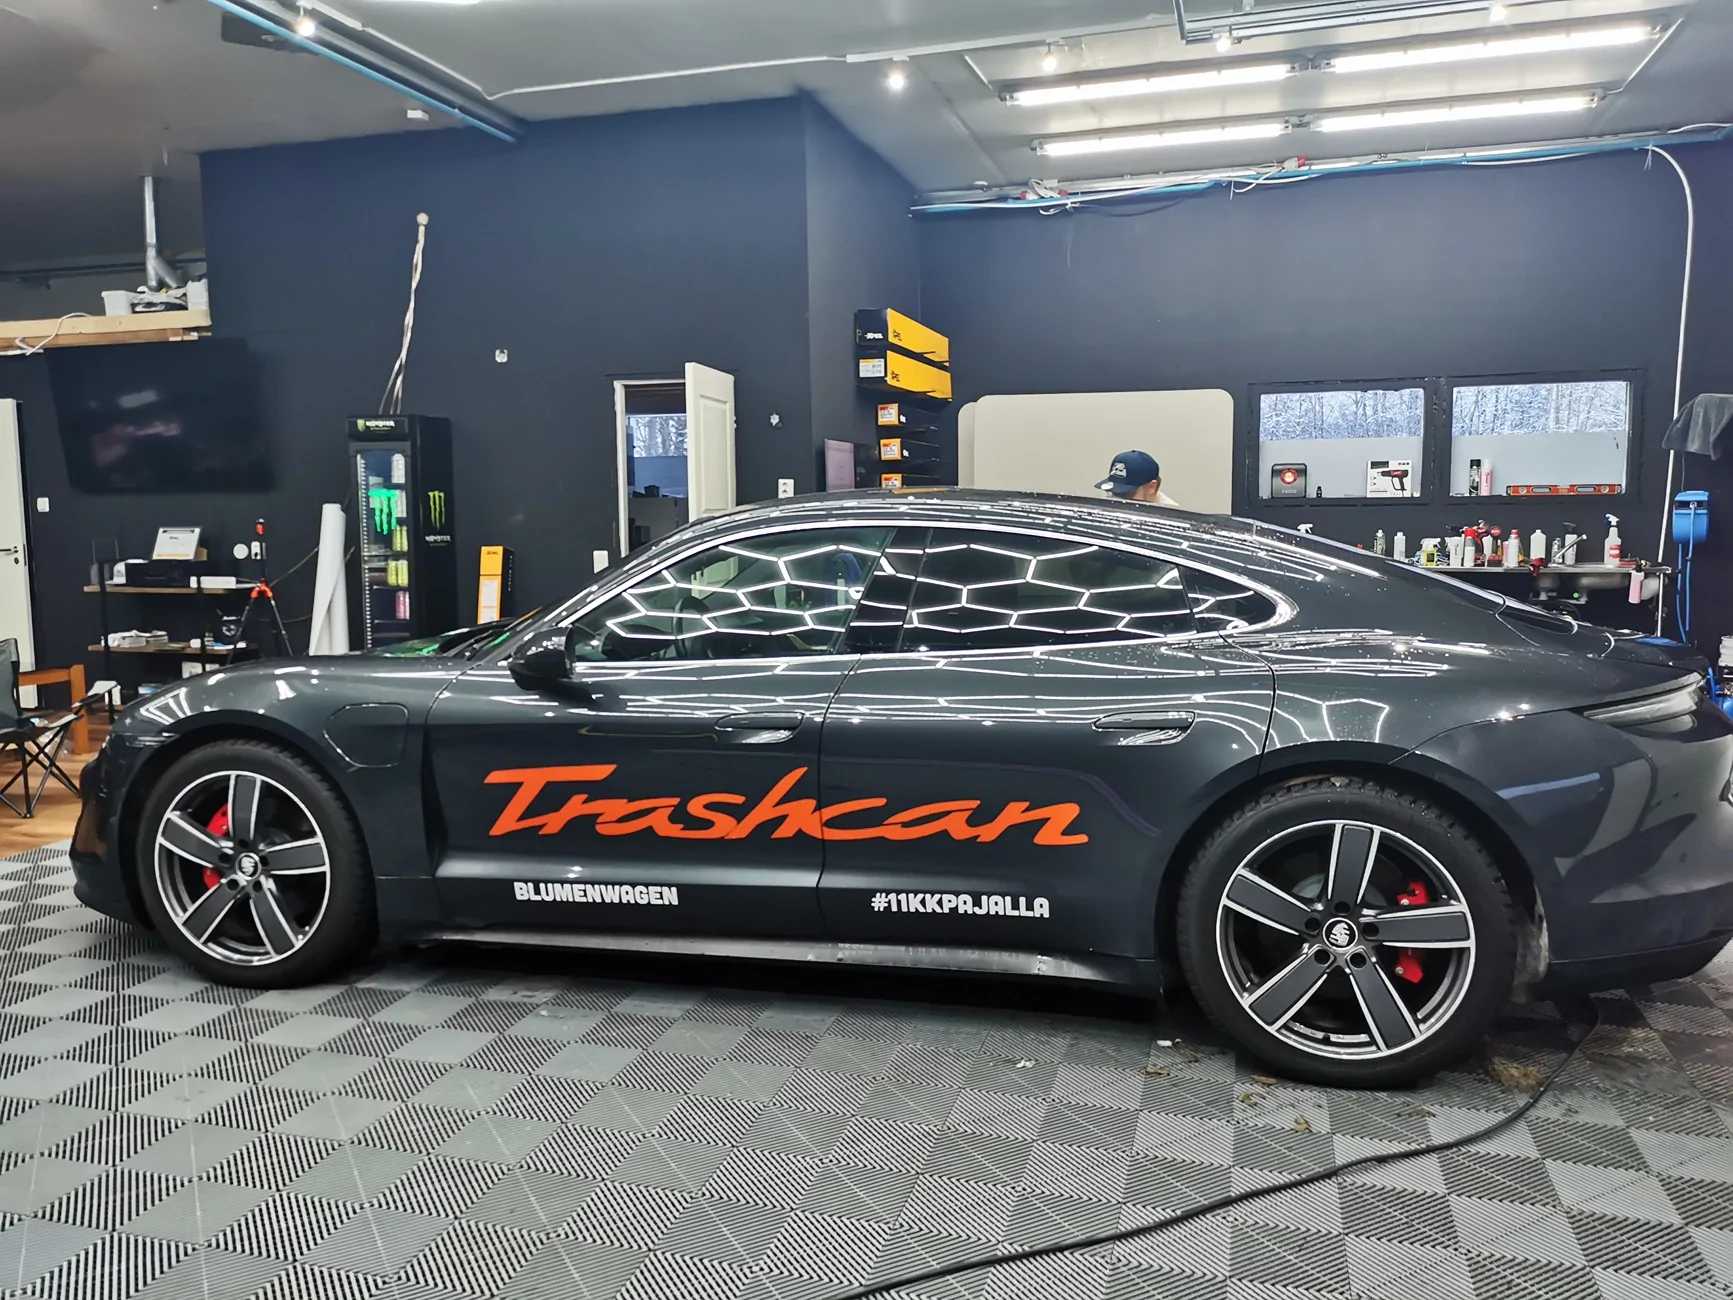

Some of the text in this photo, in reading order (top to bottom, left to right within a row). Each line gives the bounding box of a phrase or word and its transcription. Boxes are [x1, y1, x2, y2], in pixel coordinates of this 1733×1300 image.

[484, 764, 1089, 846] Trashcan
[513, 881, 679, 906] BLUMENWAGEN
[870, 892, 1050, 919] #11KKPAJALLA
